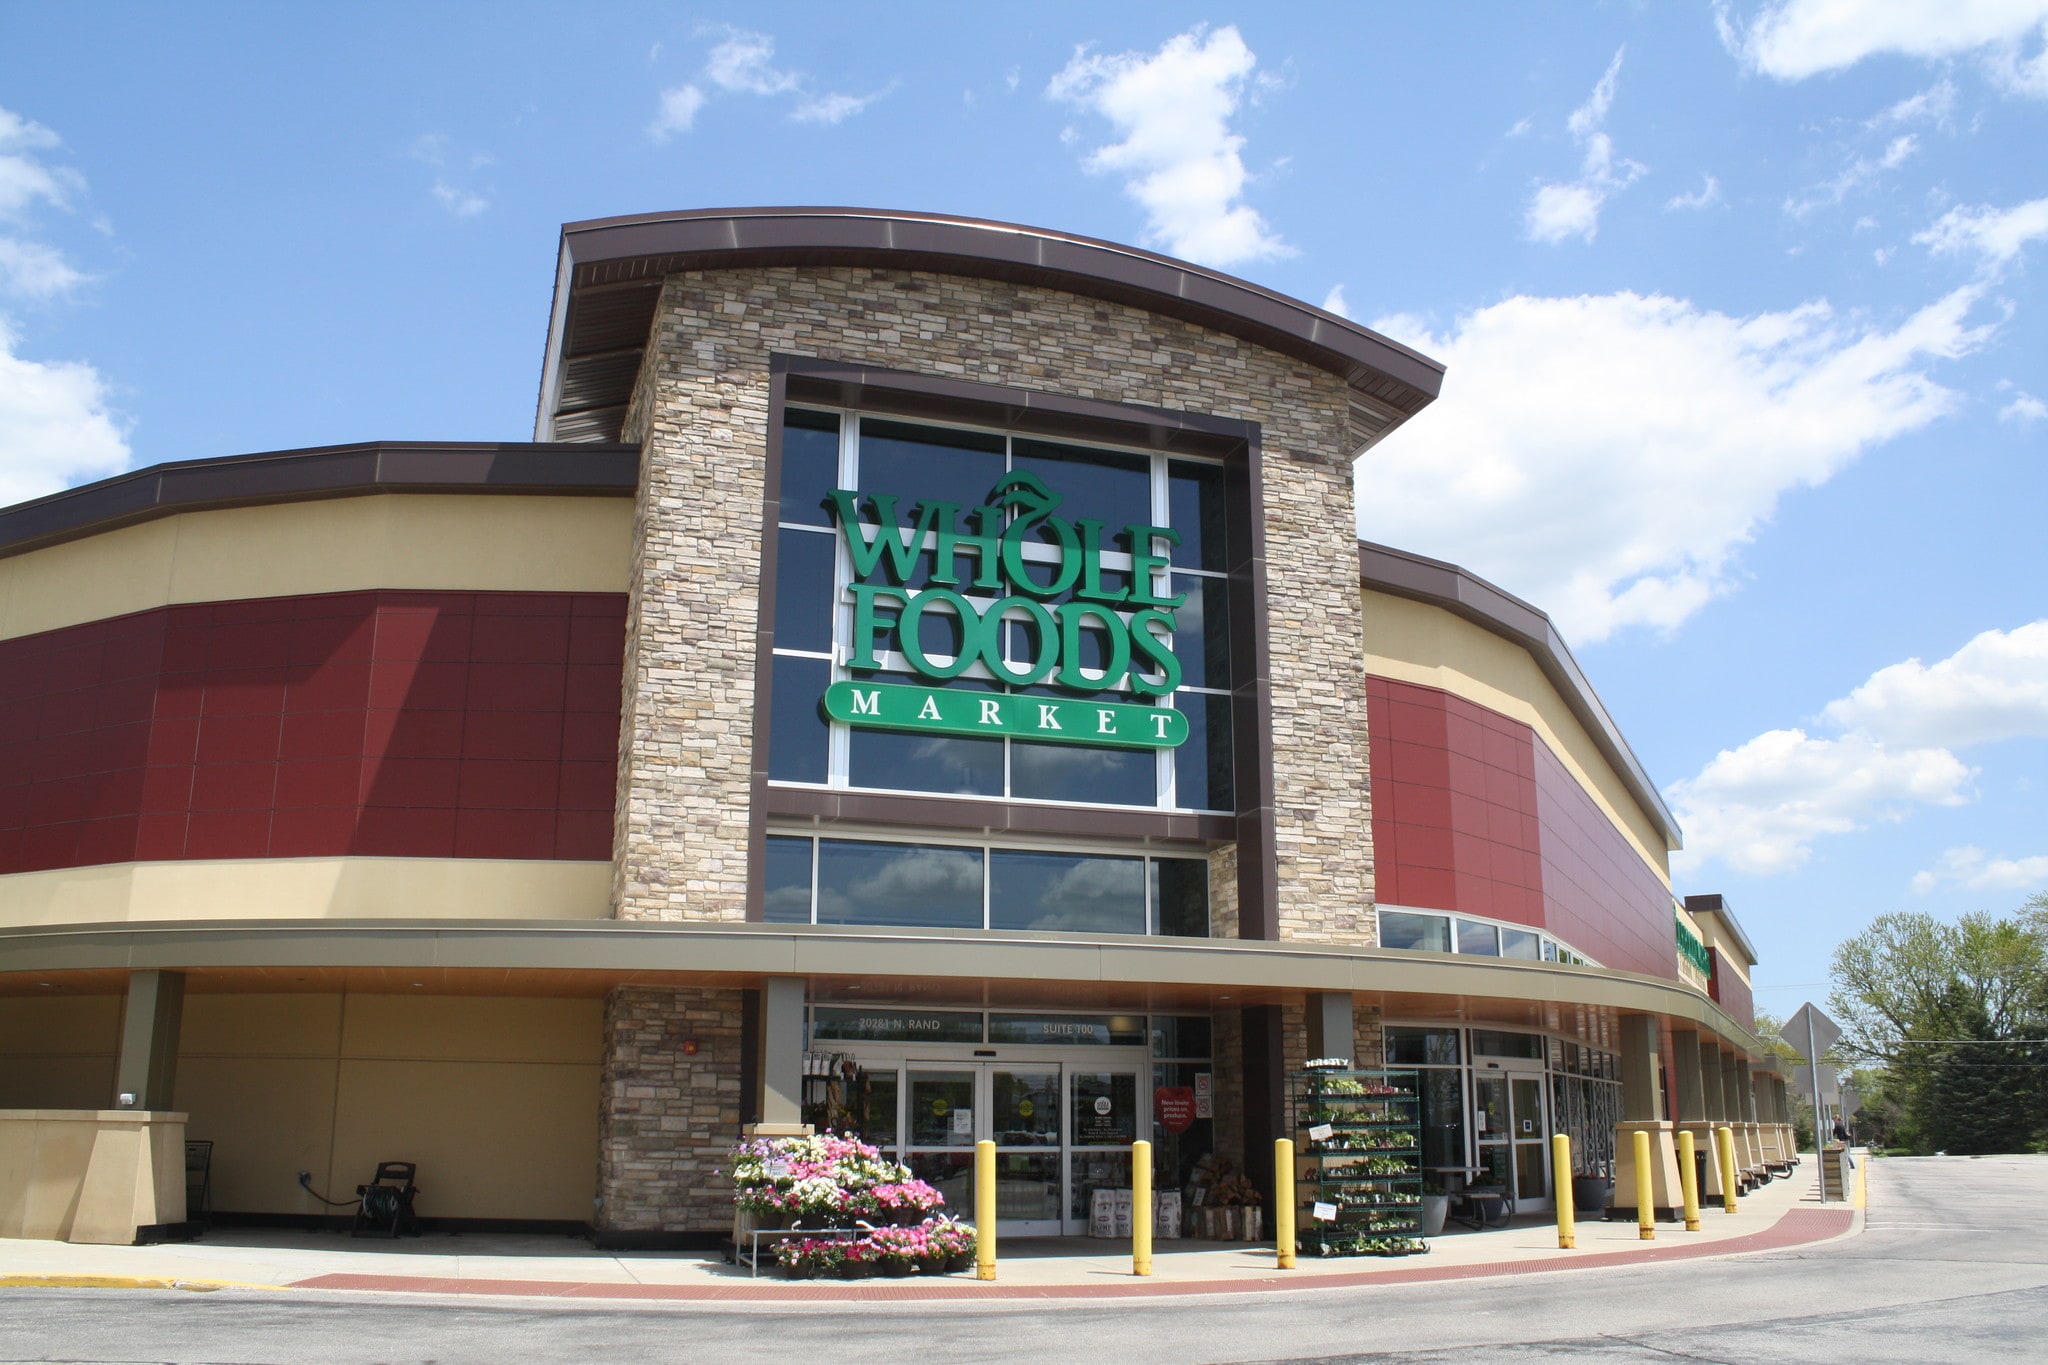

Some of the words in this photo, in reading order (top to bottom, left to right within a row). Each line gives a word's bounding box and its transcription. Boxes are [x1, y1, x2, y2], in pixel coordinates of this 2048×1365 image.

[827, 469, 1187, 608] WHOLE
[847, 583, 1182, 696] FOODS
[850, 689, 1172, 739] MARKET
[859, 1018, 889, 1029] 20281
[893, 1019, 905, 1029] N.
[908, 1019, 940, 1030] RAND
[1043, 1023, 1073, 1034] SUITE
[1075, 1024, 1093, 1034] 100
[1163, 1105, 1180, 1113] prices
